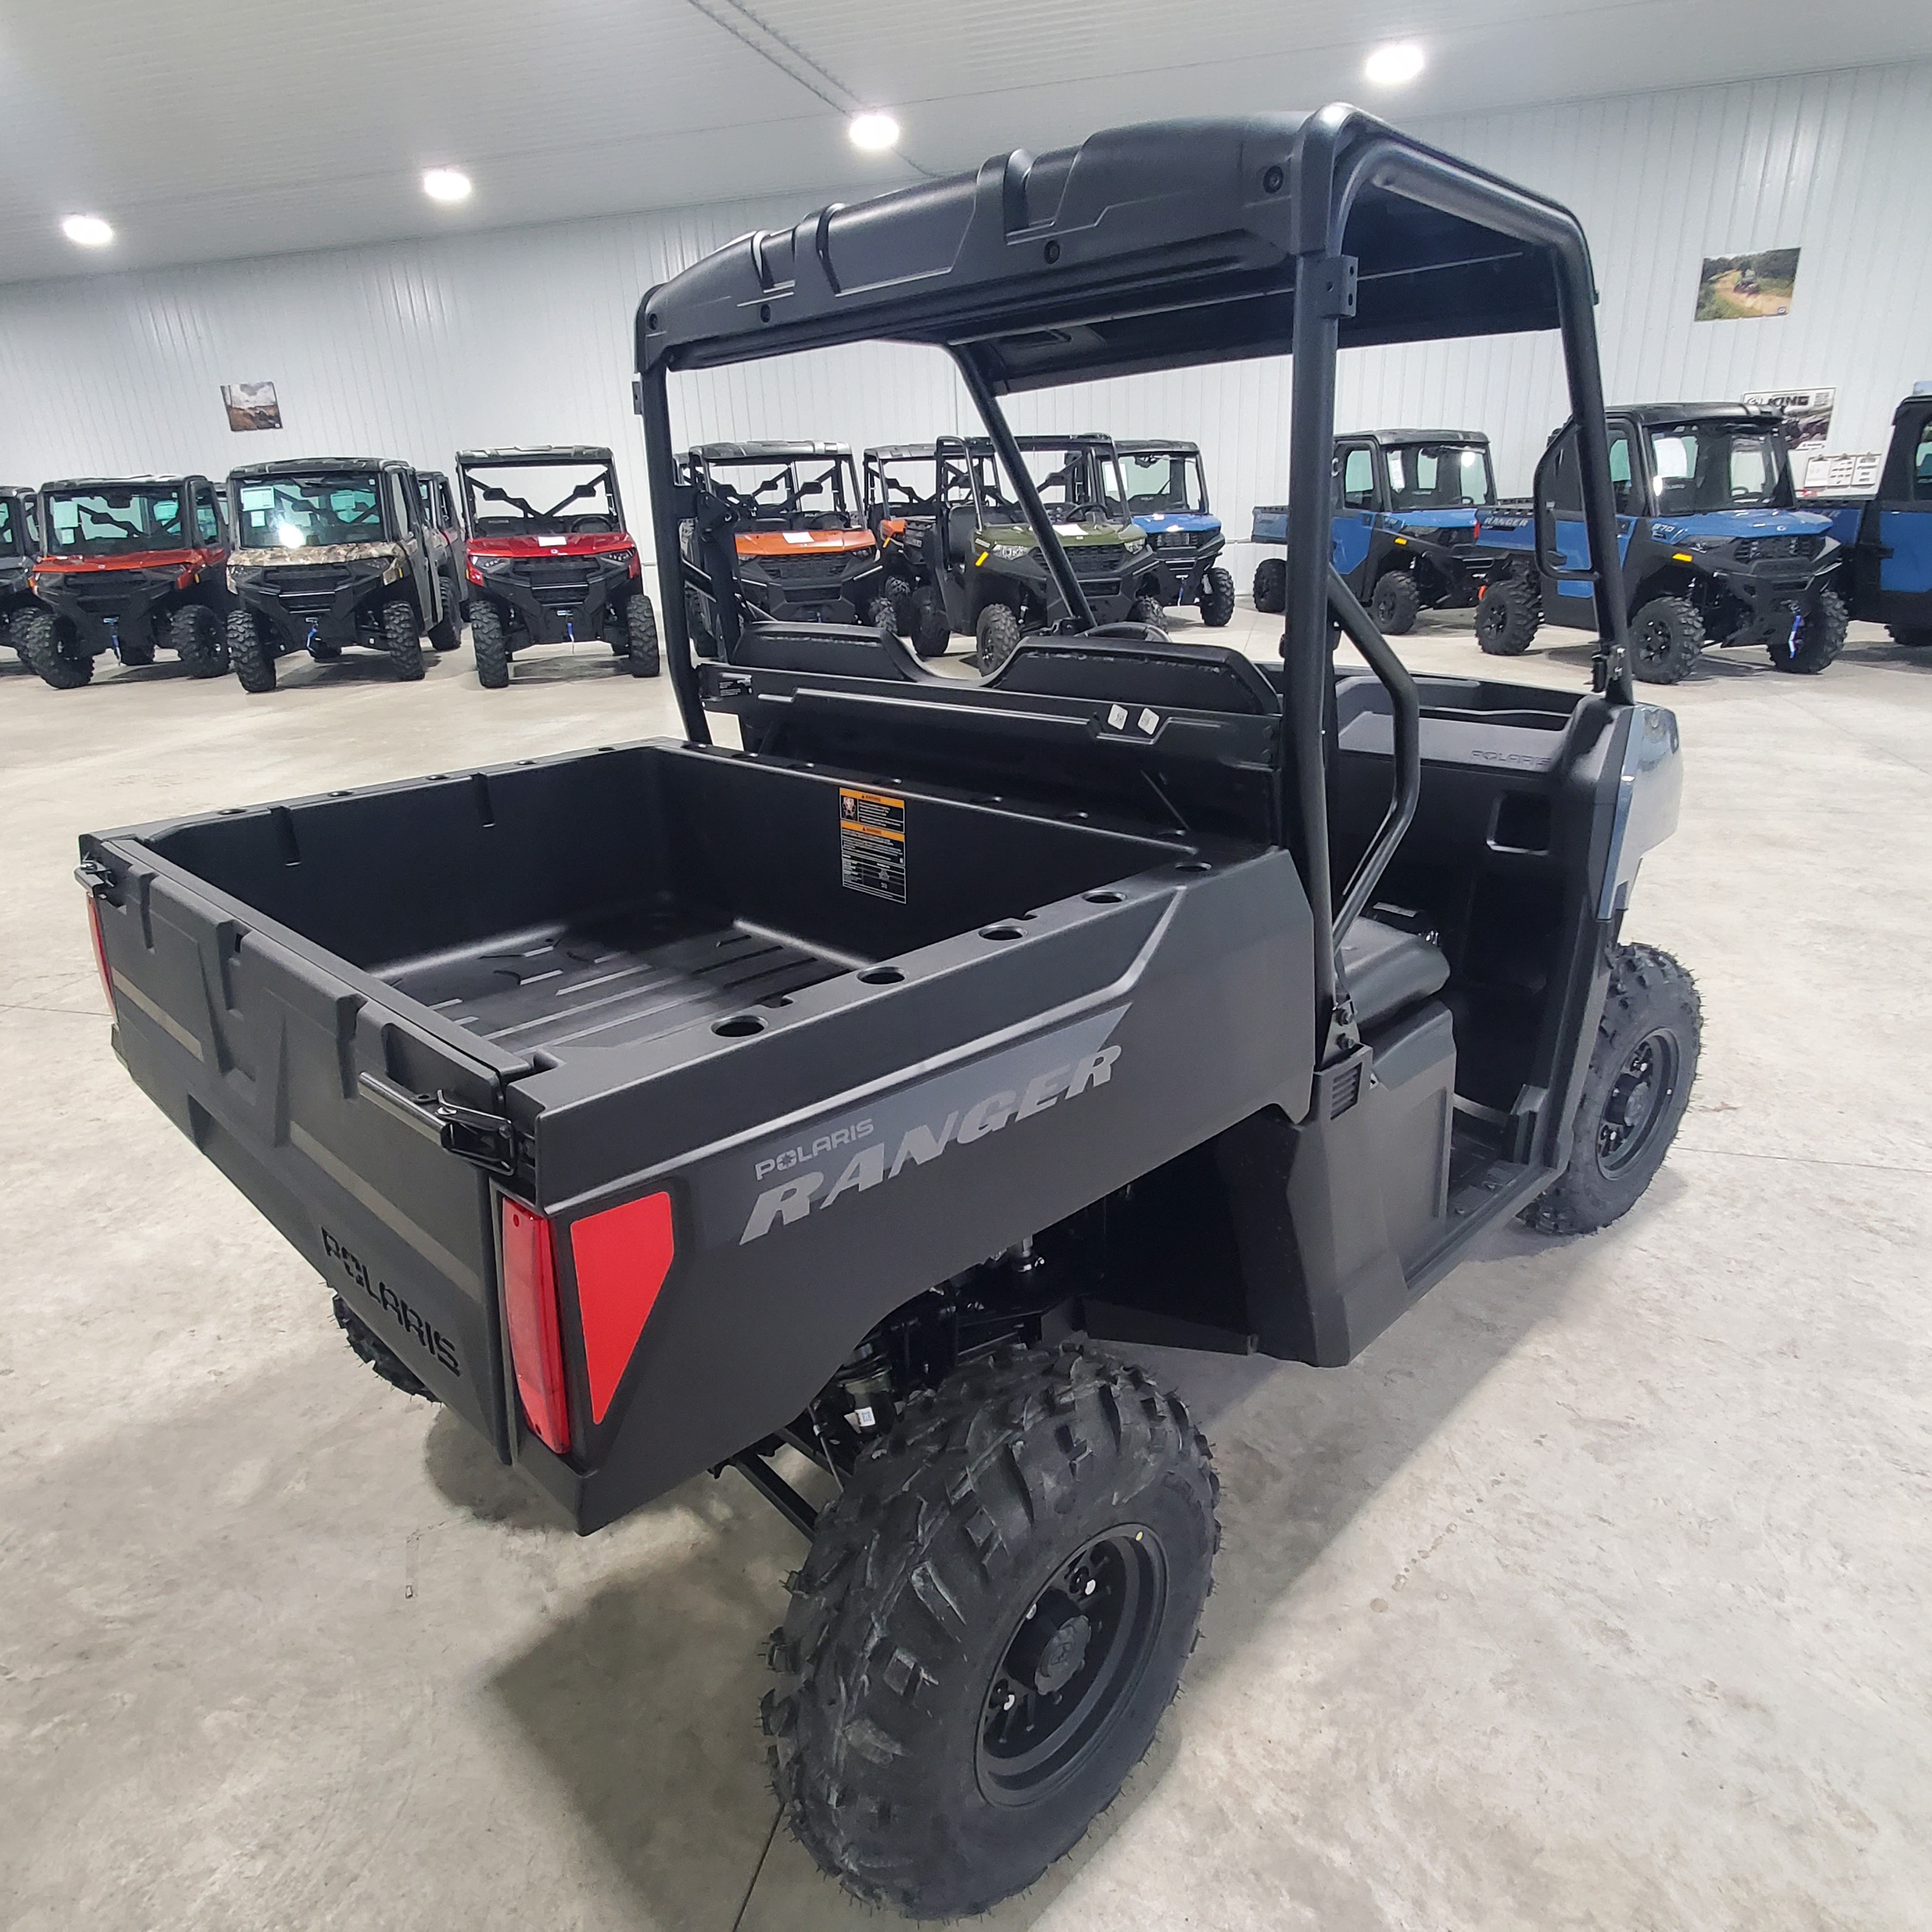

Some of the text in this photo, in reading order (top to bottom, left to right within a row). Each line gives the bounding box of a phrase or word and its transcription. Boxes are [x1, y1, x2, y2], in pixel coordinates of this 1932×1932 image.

[1483, 517, 1528, 527] RANGER
[1471, 750, 1552, 766] POLARIS
[738, 1045, 1122, 1246] RANGER
[754, 1118, 874, 1181] POLARIS
[321, 1226, 461, 1377] POLARIS
